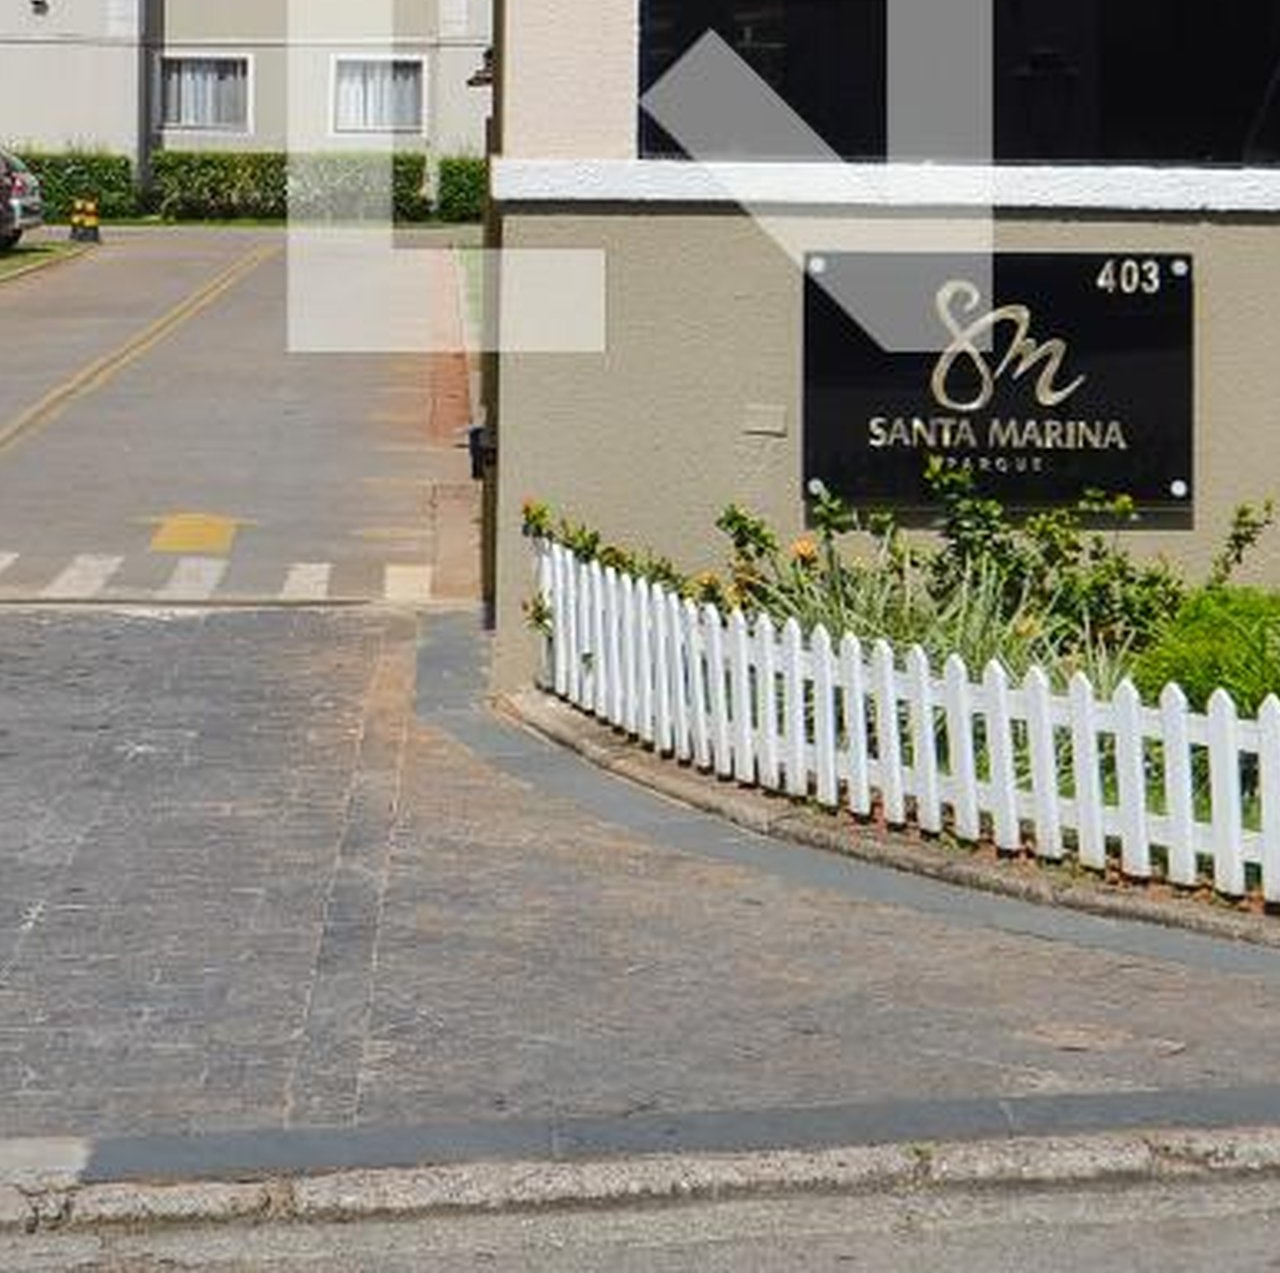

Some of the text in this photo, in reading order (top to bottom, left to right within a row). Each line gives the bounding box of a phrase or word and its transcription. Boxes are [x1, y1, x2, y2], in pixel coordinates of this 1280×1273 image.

[1096, 259, 1161, 294] 403
[868, 417, 1128, 450] SANTA MARINA
[946, 456, 1043, 473] PARQUE
